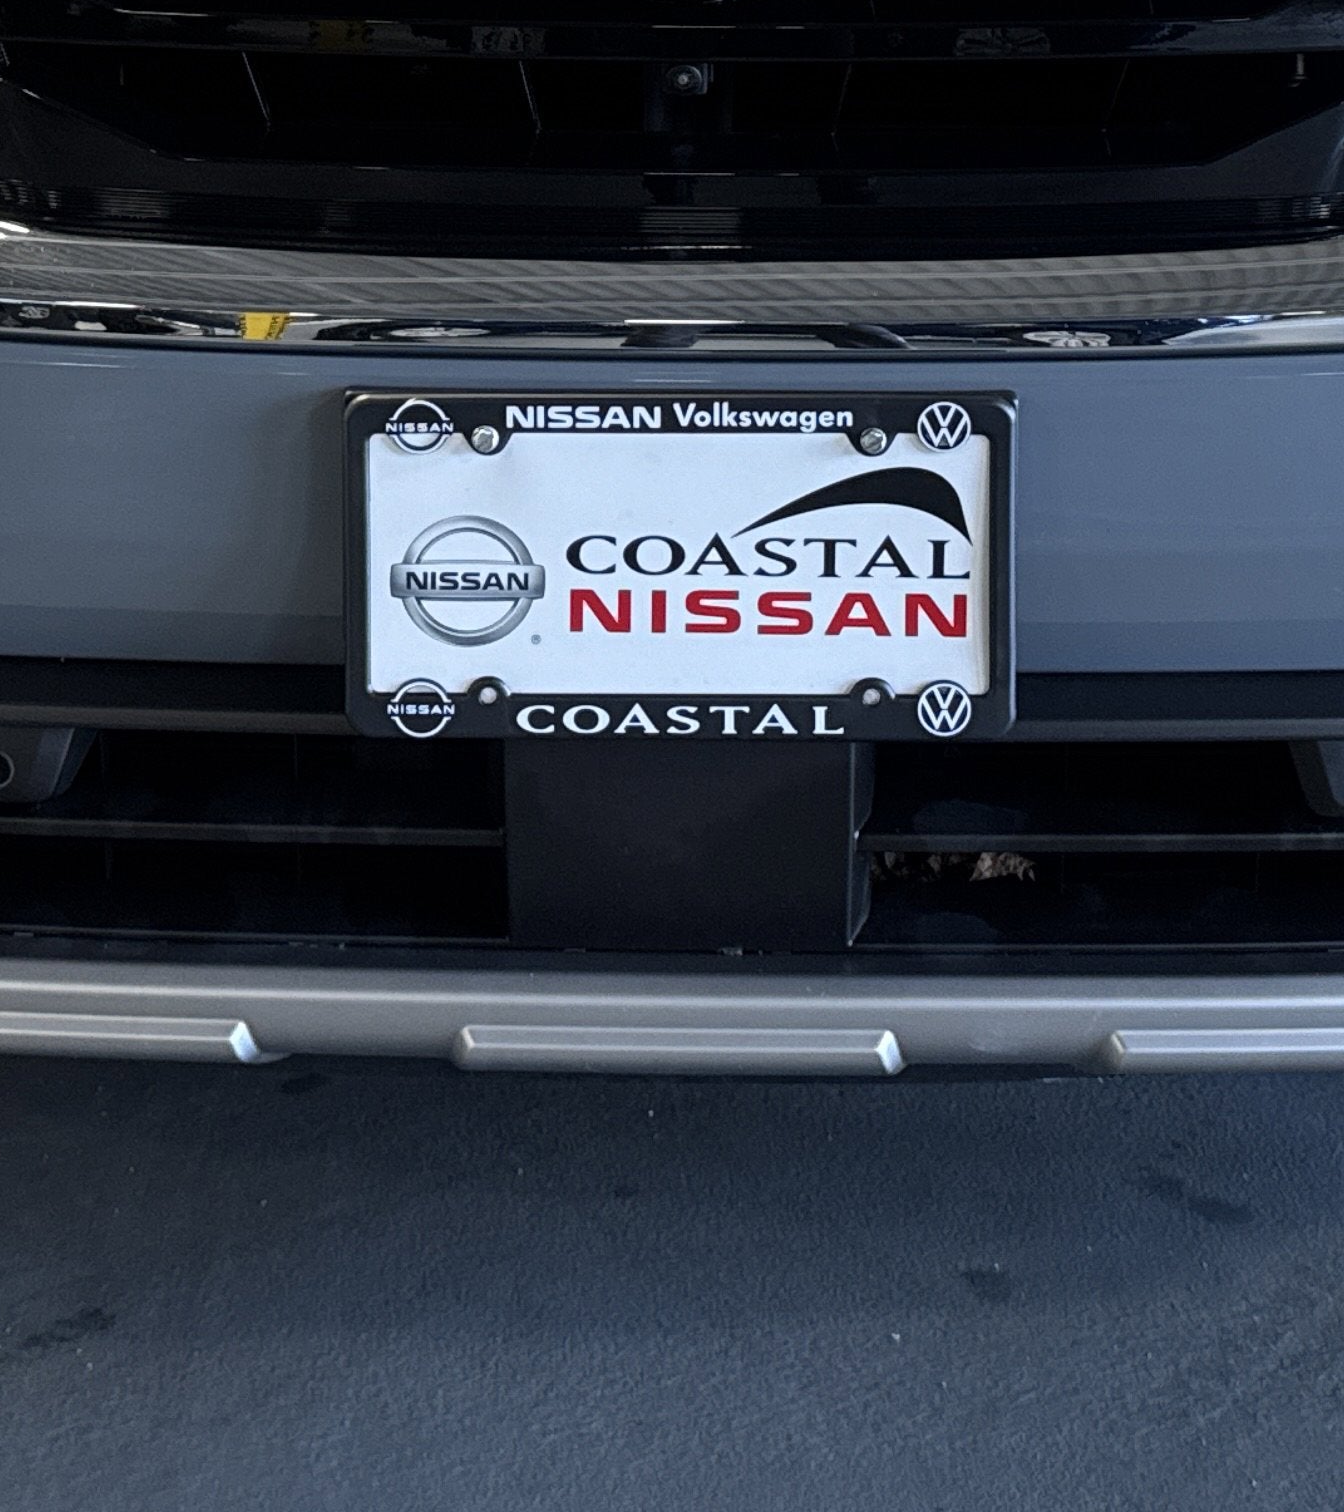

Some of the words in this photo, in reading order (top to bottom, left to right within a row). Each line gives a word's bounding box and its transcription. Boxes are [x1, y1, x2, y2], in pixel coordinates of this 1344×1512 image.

[385, 421, 454, 433] NISSAN
[506, 405, 662, 429] NISSAN
[672, 401, 854, 433] Volkswagen
[565, 532, 971, 580] COASTAL
[405, 571, 530, 591] NISSAN
[569, 588, 968, 638] NISSAN
[387, 703, 455, 716] NISSAN
[515, 702, 845, 735] COASTAL
